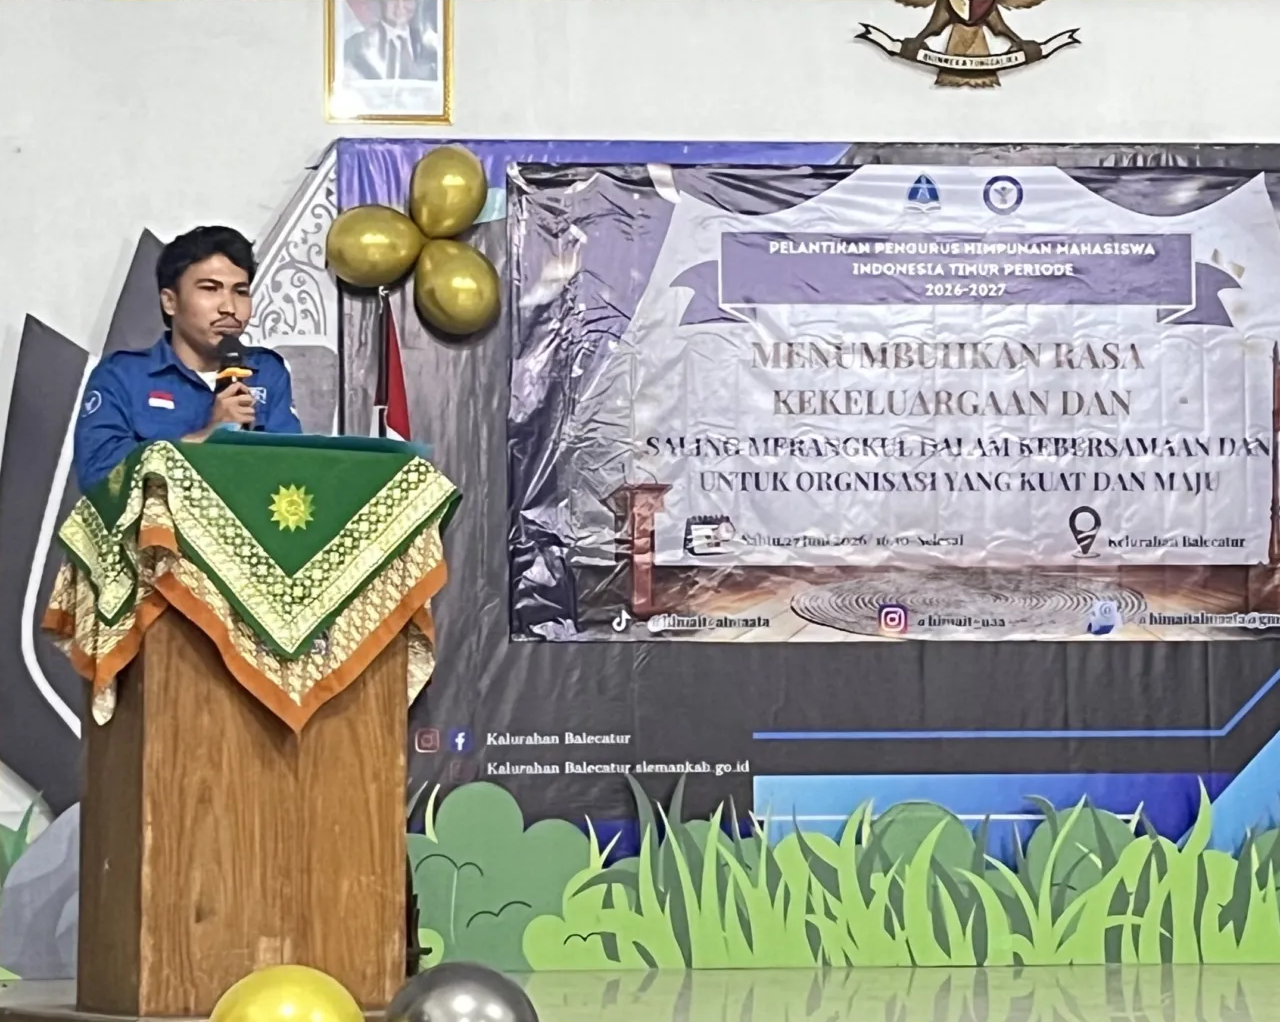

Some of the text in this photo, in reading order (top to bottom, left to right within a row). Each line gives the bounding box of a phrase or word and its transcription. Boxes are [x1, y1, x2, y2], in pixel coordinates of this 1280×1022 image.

[770, 240, 1156, 256] PELANTIKAN PENGURUS HIMPUNAN MAHASISWA
[852, 262, 1074, 277] INDONESIA TIMUR PERIODE
[925, 283, 1007, 297] 2026-2027
[750, 341, 1145, 370] MENUMBUHKAN RASA
[773, 389, 1132, 416] KEKELUARGAAN DAN
[646, 436, 741, 458] SALING
[748, 436, 913, 458] MERANGKUL
[1020, 436, 1211, 458] KEBERSAMAAN
[1219, 436, 1271, 458] DAN
[699, 471, 1222, 496] UNTUK ORGNISASI YANG KUAT DAN MAJU
[486, 732, 631, 746] Kalurahan Balecatur
[486, 761, 560, 775] Kalurahan
